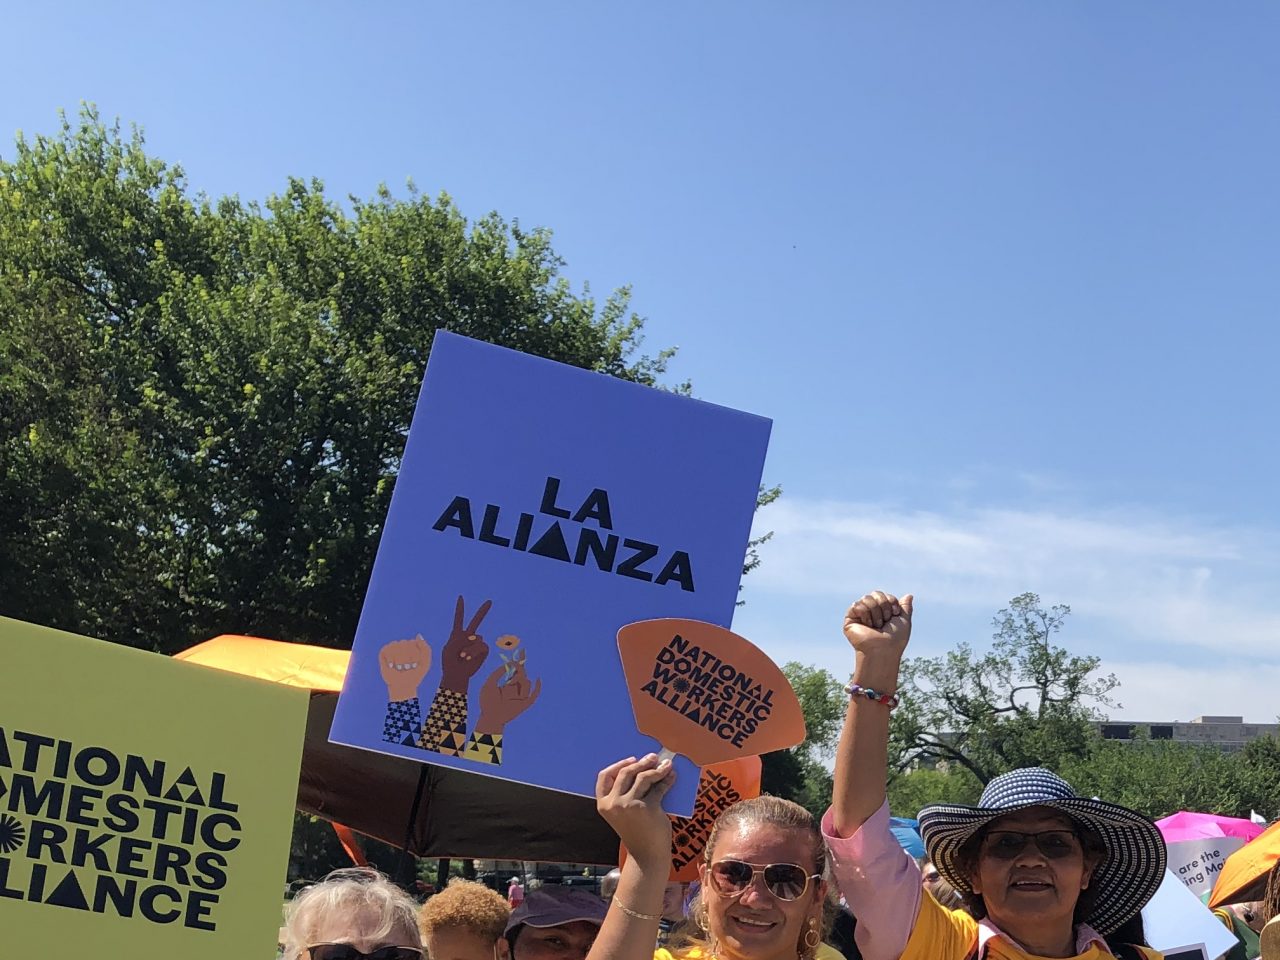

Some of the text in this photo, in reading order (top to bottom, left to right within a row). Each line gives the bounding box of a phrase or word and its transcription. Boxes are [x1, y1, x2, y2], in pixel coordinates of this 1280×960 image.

[540, 476, 613, 530] LA
[432, 496, 695, 592] ALIANZA
[652, 662, 759, 735] WORKERS
[655, 647, 771, 722] DOMESTIC
[668, 634, 774, 708] NATIONAL
[640, 679, 749, 749] ALLIANCE
[0, 727, 239, 812] TIONAL
[0, 773, 242, 851] MESTIC
[0, 857, 220, 931] LIANCE
[1179, 859, 1199, 875] are
[1200, 849, 1221, 866] the
